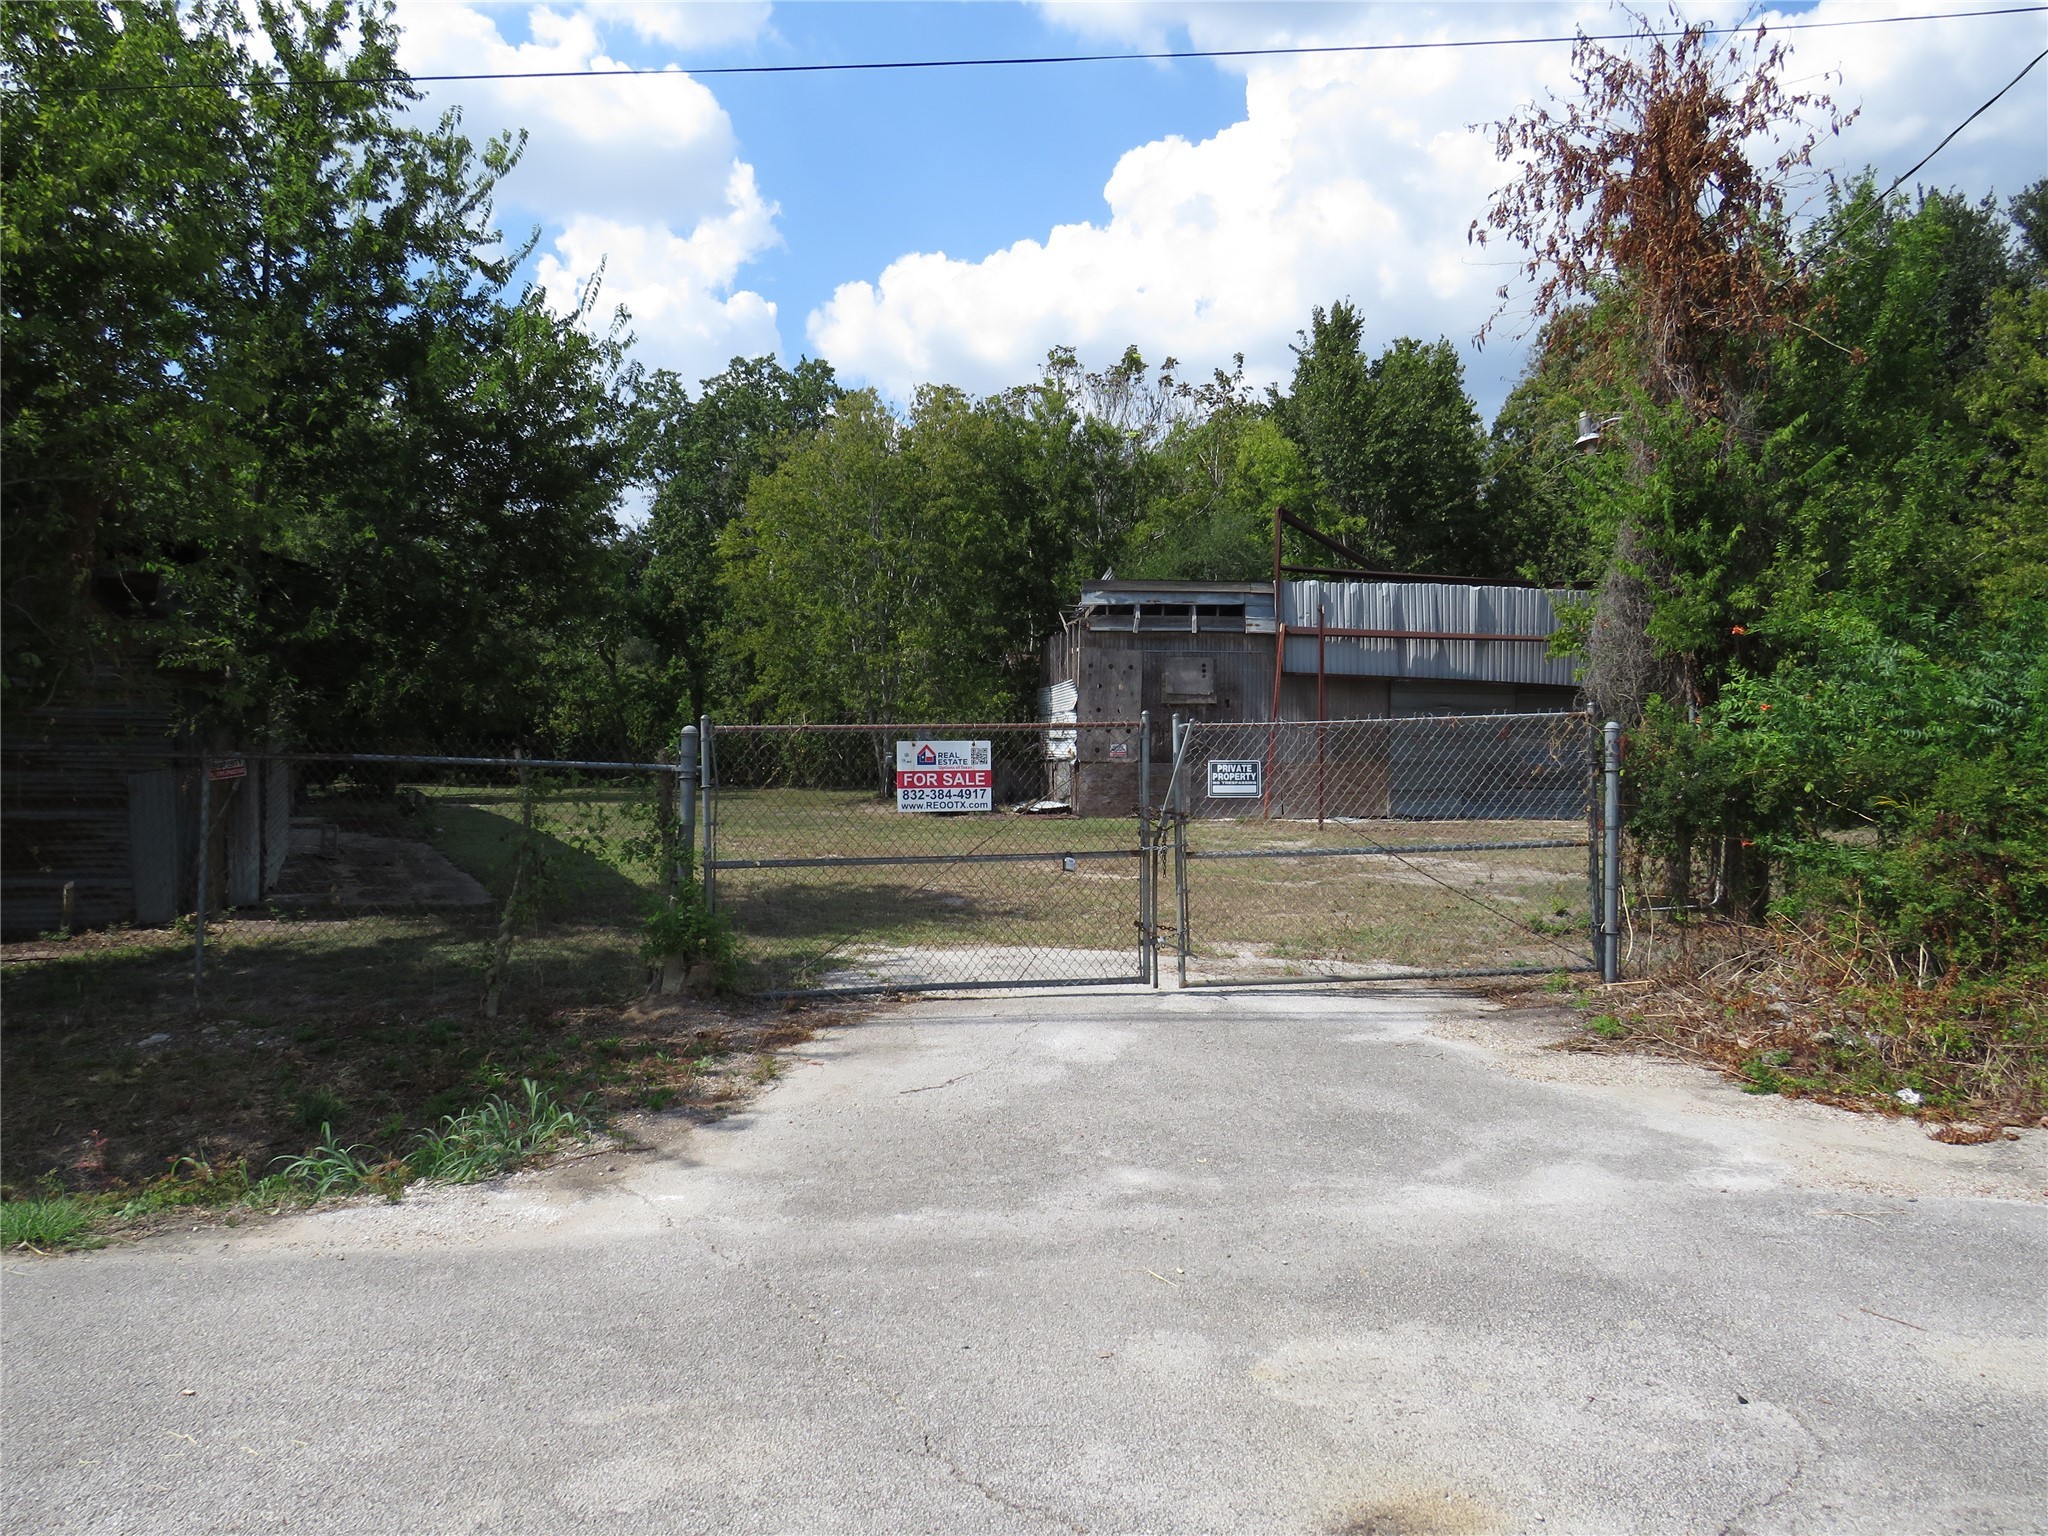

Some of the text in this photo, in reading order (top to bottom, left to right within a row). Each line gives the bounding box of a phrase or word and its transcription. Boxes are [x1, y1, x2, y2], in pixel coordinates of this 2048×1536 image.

[1216, 764, 1252, 772] PRIVATE
[904, 772, 986, 786] FOR SALE
[902, 789, 986, 800] 832-384-4917
[902, 802, 988, 810] www.REOOTX.com
